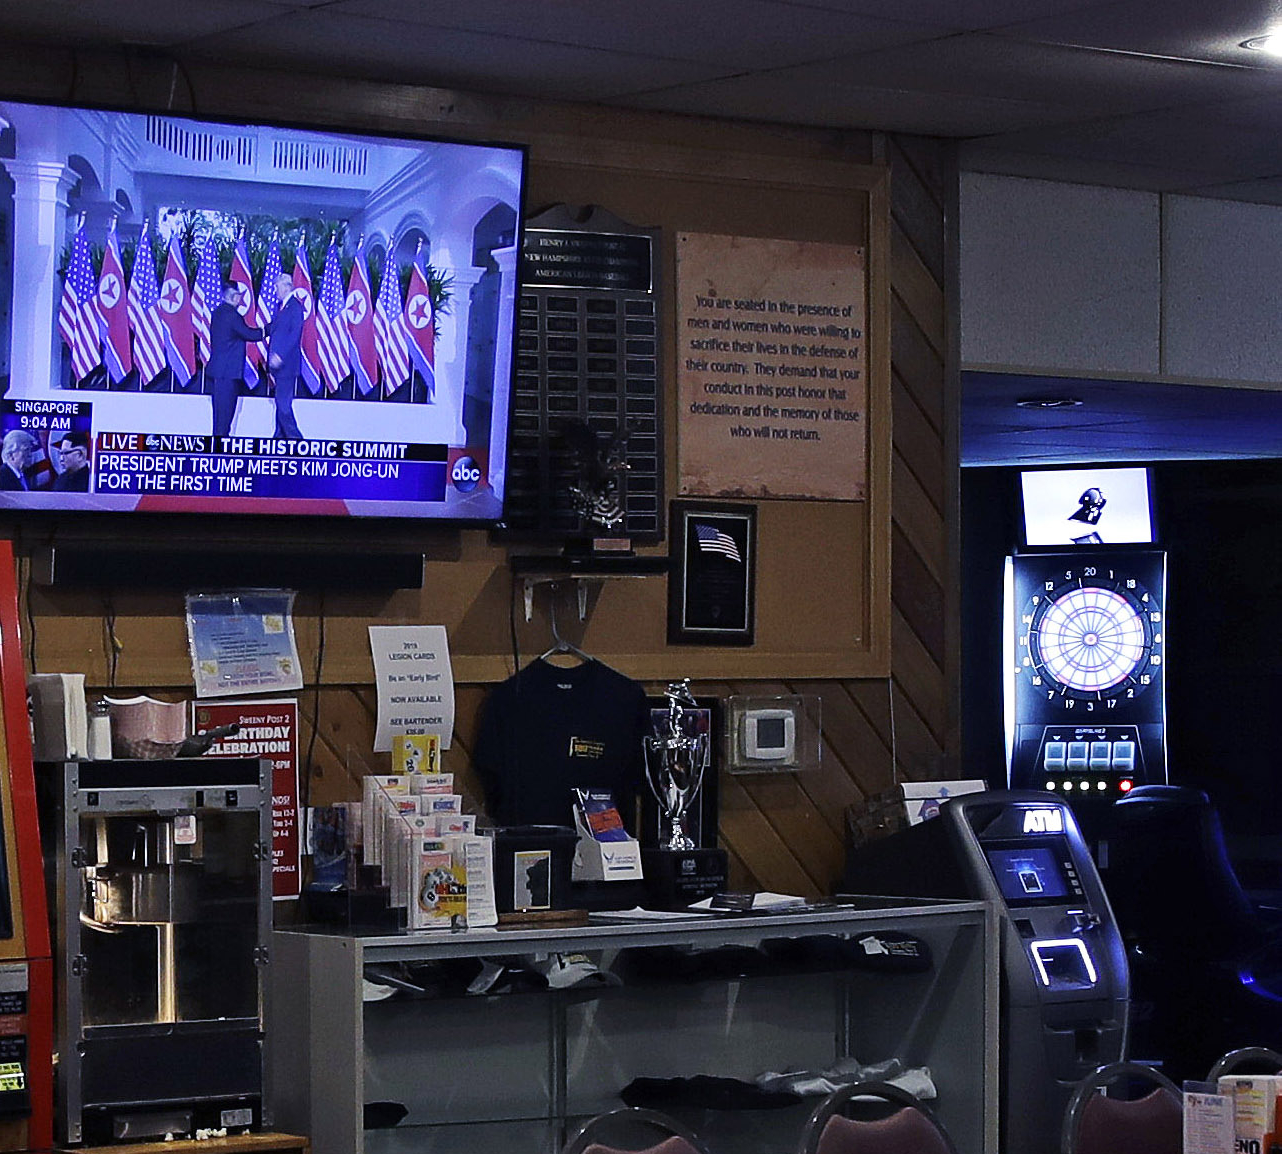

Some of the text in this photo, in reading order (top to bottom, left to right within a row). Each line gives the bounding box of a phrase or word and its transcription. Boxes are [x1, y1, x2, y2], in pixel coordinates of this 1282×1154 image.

[696, 294, 852, 317] You are seated in the presence of
[704, 382, 847, 400] conduct in this post honor that
[15, 400, 79, 415] SINGAPORE
[20, 414, 71, 430] 9:04 AM
[730, 425, 821, 441] who will not return.
[101, 433, 138, 451] LIVE
[160, 435, 205, 453] NEWS
[221, 438, 255, 455] THE
[258, 439, 338, 458] HISTORIC
[341, 441, 408, 459] SUMMIT
[99, 454, 399, 480] PRESIDENT TRUMP MEETS KIM JONG-UN
[451, 464, 481, 483] abc
[97, 473, 253, 493] FOR THE FIRST TIME
[1083, 567, 1097, 576] 20
[1140, 675, 1150, 684] 15
[1065, 699, 1074, 709] 19
[1107, 699, 1116, 709] 17
[284, 714, 290, 724] 2
[1023, 809, 1063, 833] ATM
